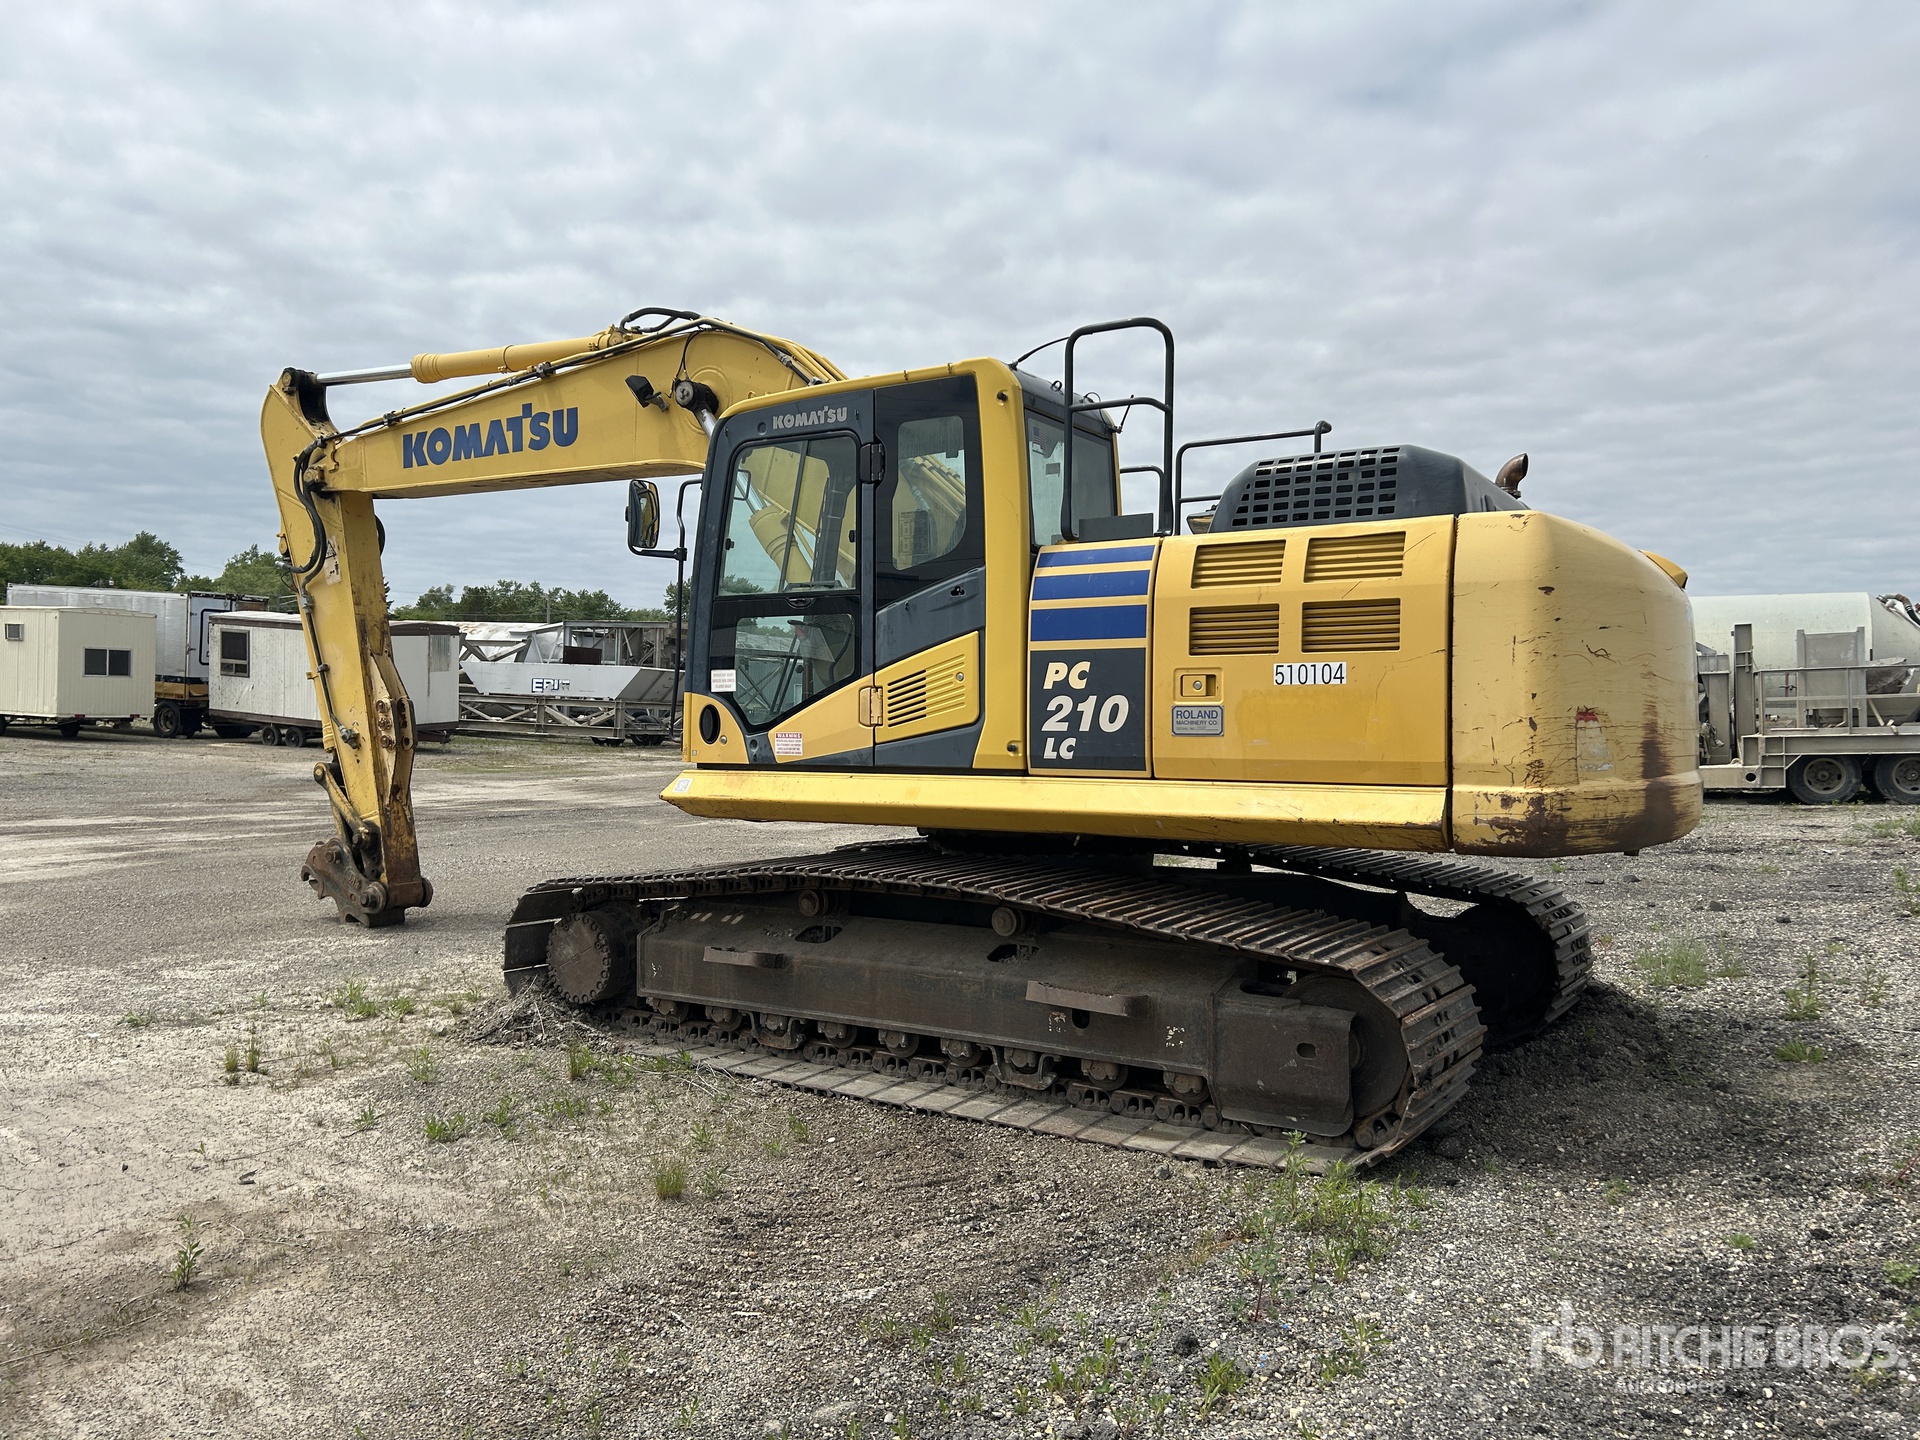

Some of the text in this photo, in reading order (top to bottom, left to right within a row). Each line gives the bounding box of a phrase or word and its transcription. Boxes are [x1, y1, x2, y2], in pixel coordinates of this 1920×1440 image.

[773, 406, 848, 430] KOMATSU
[403, 403, 578, 469] KOMATSU
[1042, 661, 1091, 689] PC
[1275, 663, 1345, 685] 510104
[1041, 695, 1130, 732] 210
[1176, 710, 1219, 719] ROLAND
[1043, 738, 1076, 759] LC
